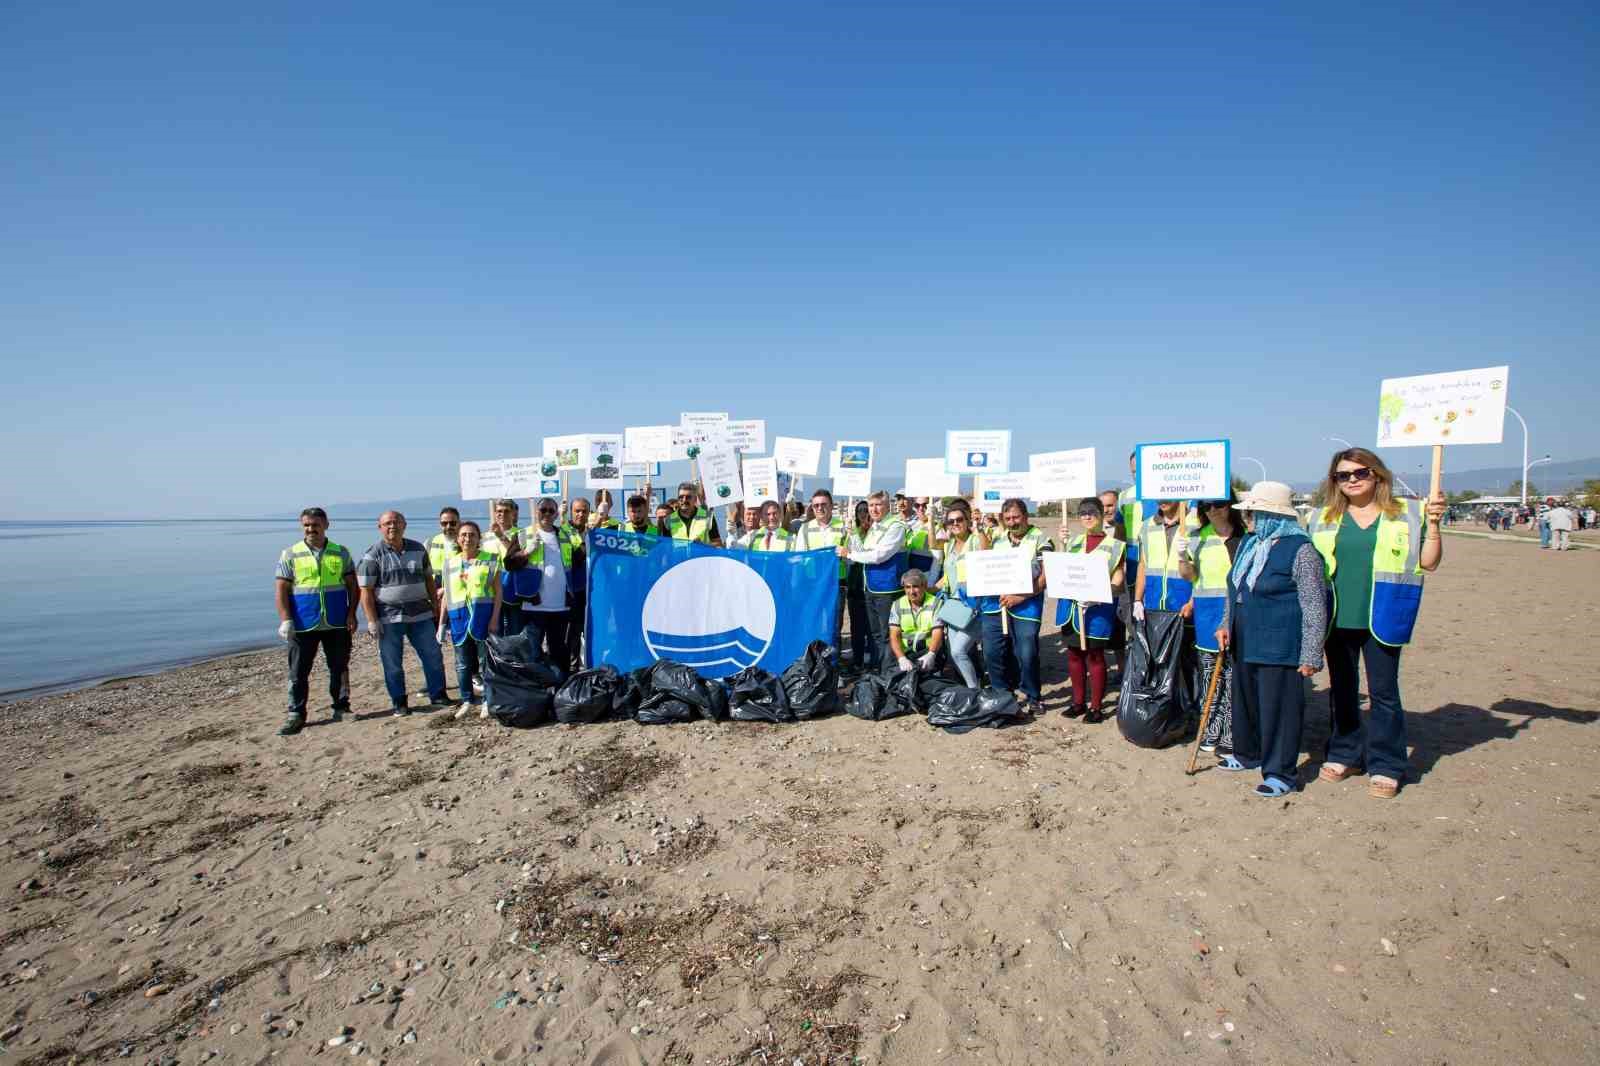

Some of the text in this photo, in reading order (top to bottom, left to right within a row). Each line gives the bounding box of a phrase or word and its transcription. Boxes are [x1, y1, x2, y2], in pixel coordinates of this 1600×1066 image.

[1159, 451, 1187, 460] YAŞAM
[1152, 462, 1183, 471] DOĞAYI
[1160, 485, 1200, 493] AYDINLAT
[595, 534, 641, 553] 2024
